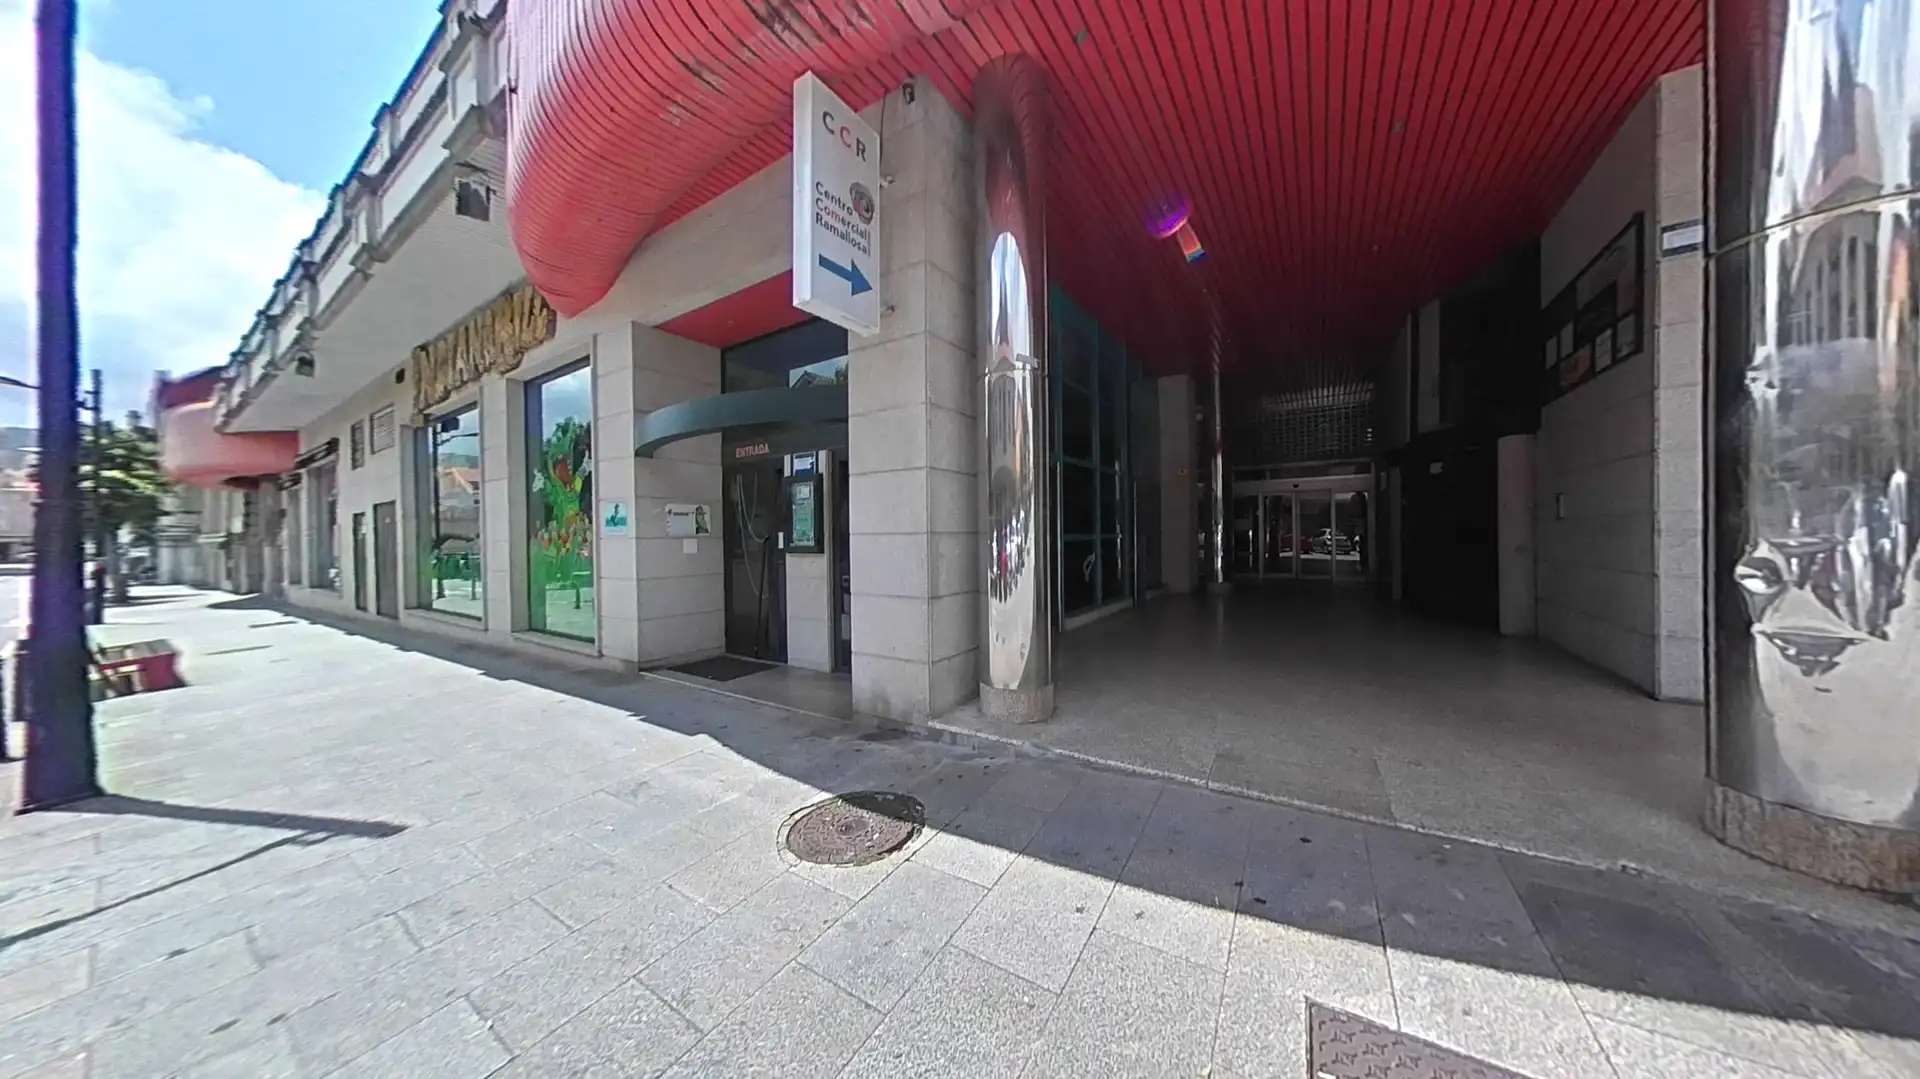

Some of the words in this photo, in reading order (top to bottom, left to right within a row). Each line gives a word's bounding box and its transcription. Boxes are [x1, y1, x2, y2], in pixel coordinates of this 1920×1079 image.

[815, 181, 854, 216] Centro
[815, 197, 867, 241] Comercial
[815, 211, 868, 254] Ramallosa
[735, 443, 770, 458] ENTRADA
